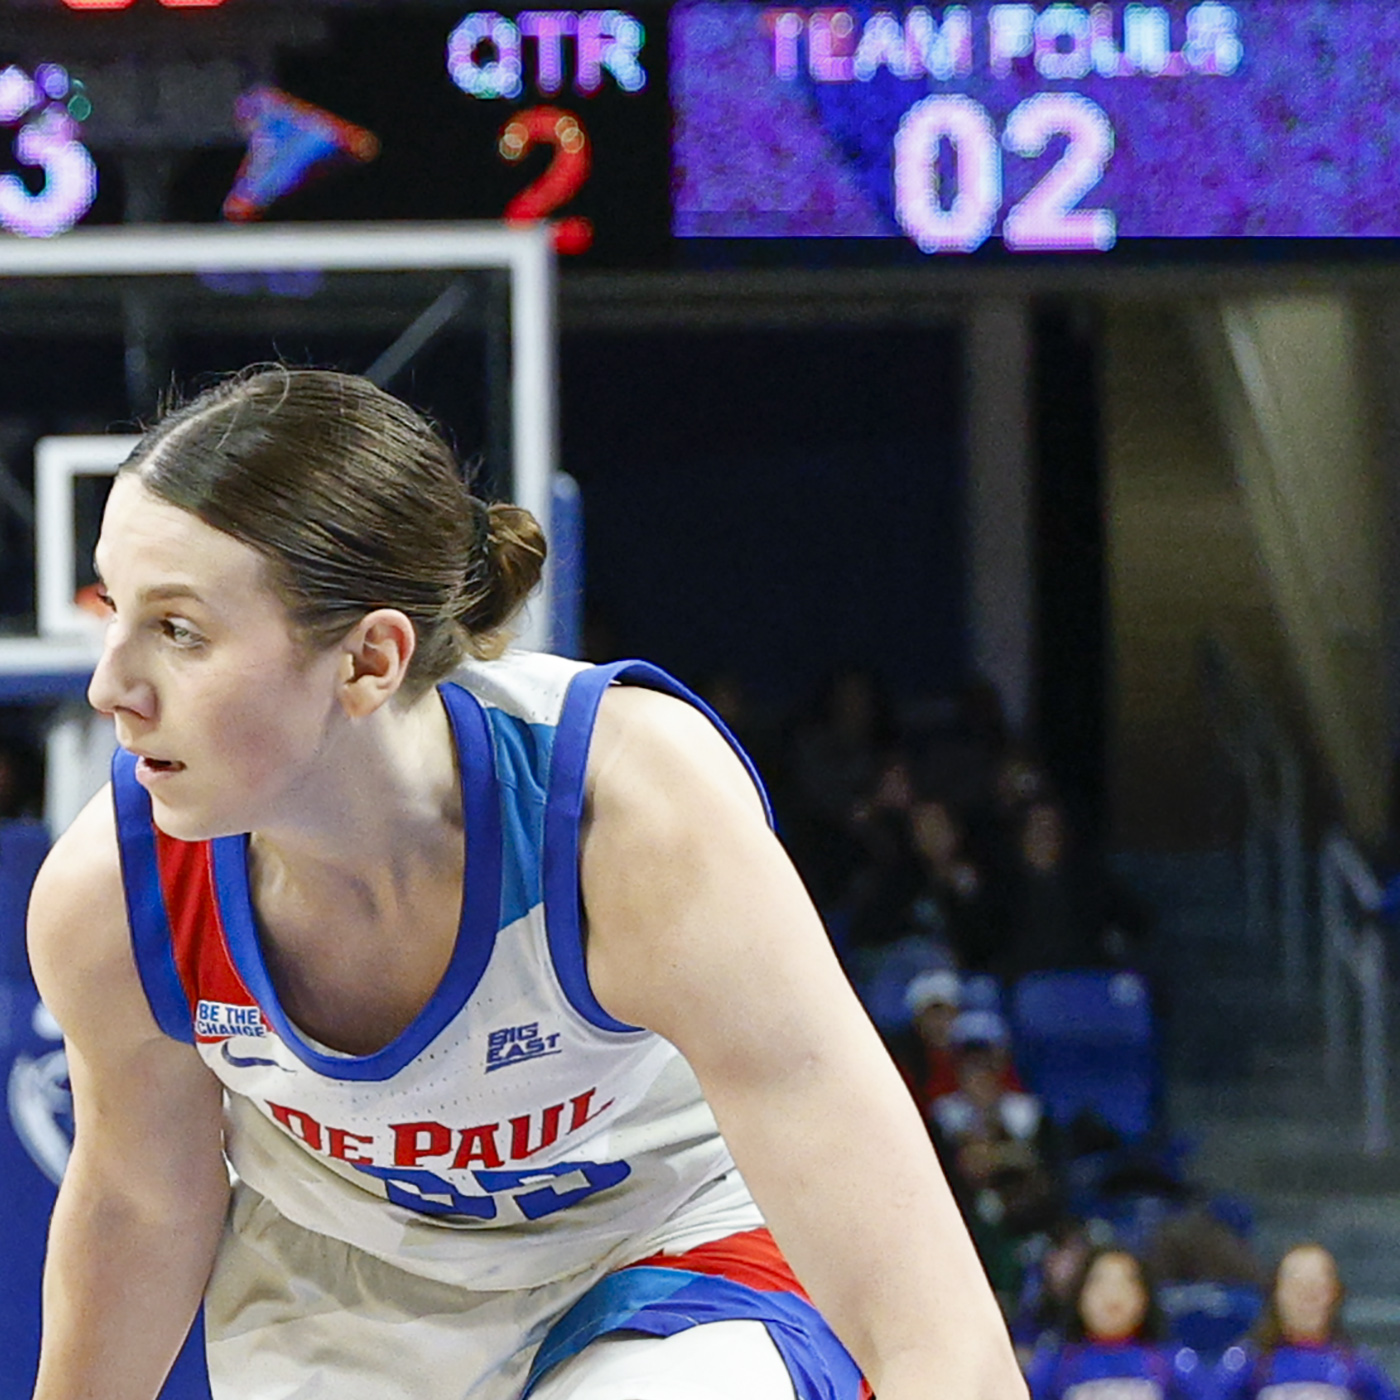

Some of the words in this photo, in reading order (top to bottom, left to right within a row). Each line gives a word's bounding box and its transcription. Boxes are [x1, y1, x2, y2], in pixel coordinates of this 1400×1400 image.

[447, 9, 646, 98] QTR
[766, 5, 974, 82] TEAM
[989, 3, 1245, 79] FOULS
[499, 105, 593, 255] 2
[893, 92, 1117, 254] 02
[197, 1021, 265, 1037] CHANGE
[199, 1003, 219, 1021] BE
[225, 1007, 258, 1025] THE
[486, 1033, 560, 1063] EAST
[488, 1022, 538, 1049] BIG
[264, 1099, 374, 1166] DE
[388, 1087, 616, 1170] PAUL
